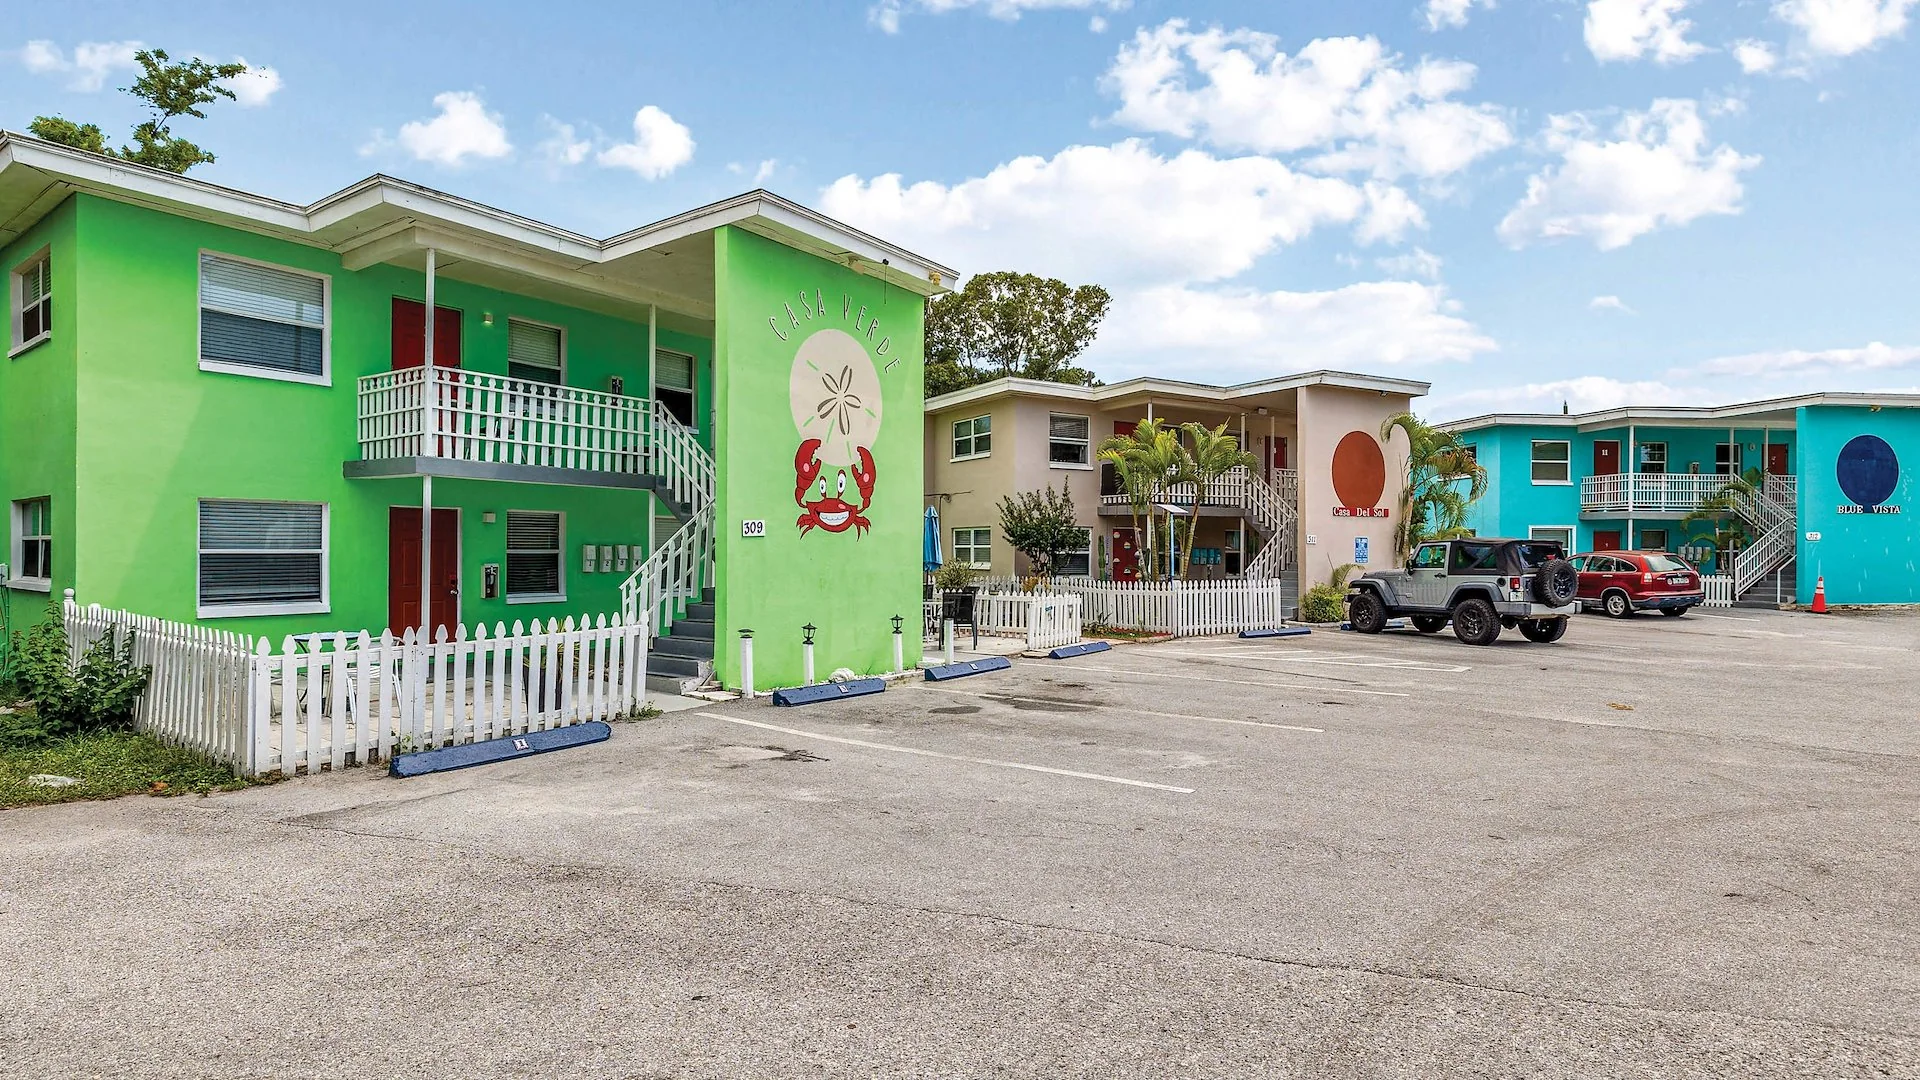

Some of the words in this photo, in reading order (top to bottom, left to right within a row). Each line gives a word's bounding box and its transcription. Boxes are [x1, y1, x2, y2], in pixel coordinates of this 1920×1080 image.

[768, 288, 825, 341] CASA
[843, 293, 901, 374] VERDE
[1333, 507, 1350, 516] Casa
[1356, 507, 1370, 517] Del
[1373, 508, 1384, 517] Sol
[1837, 505, 1864, 514] BLUE
[1872, 505, 1901, 514] VISTA
[744, 521, 763, 535] 309
